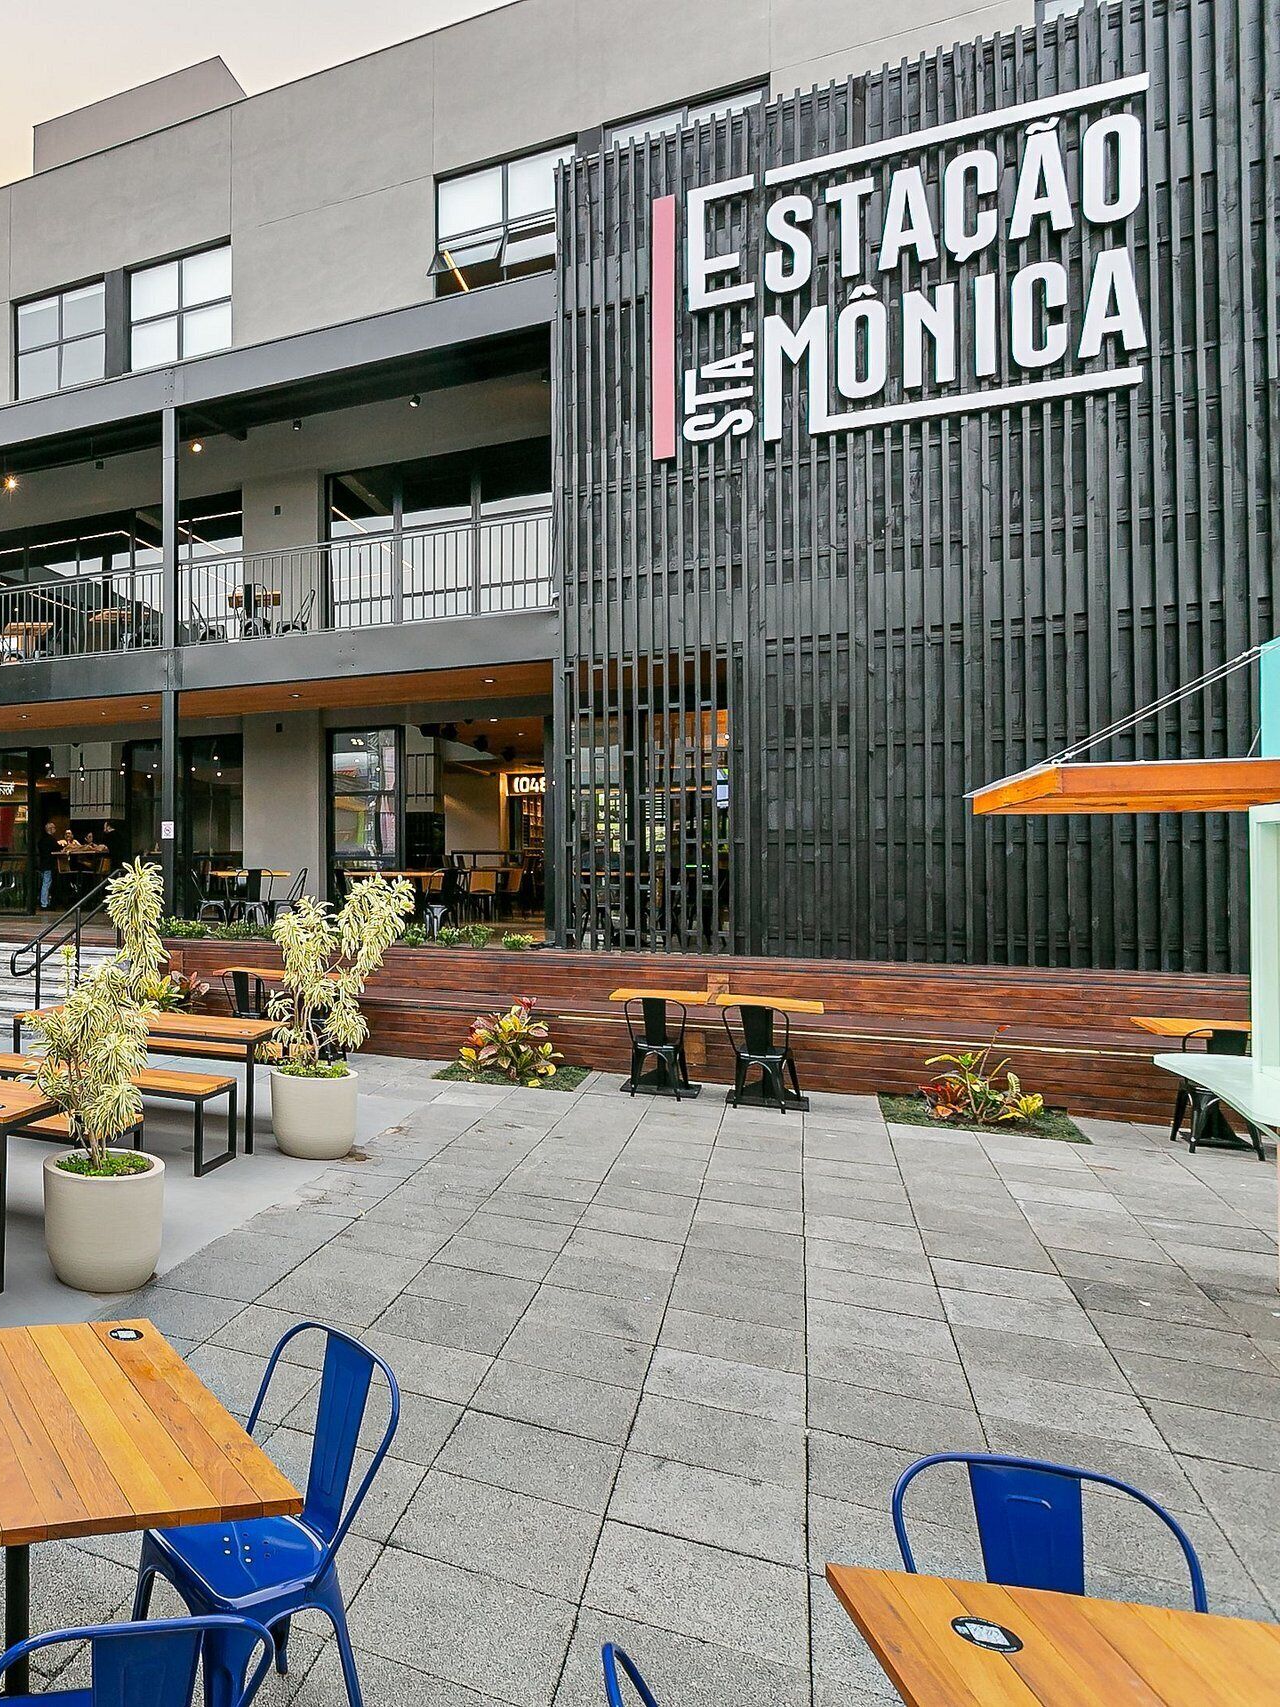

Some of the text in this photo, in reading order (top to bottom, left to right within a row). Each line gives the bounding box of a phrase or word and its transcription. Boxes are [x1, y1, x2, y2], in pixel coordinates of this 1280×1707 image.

[687, 112, 1142, 312] ESTAÇÃO
[682, 246, 1148, 442] STA. MÔNICA
